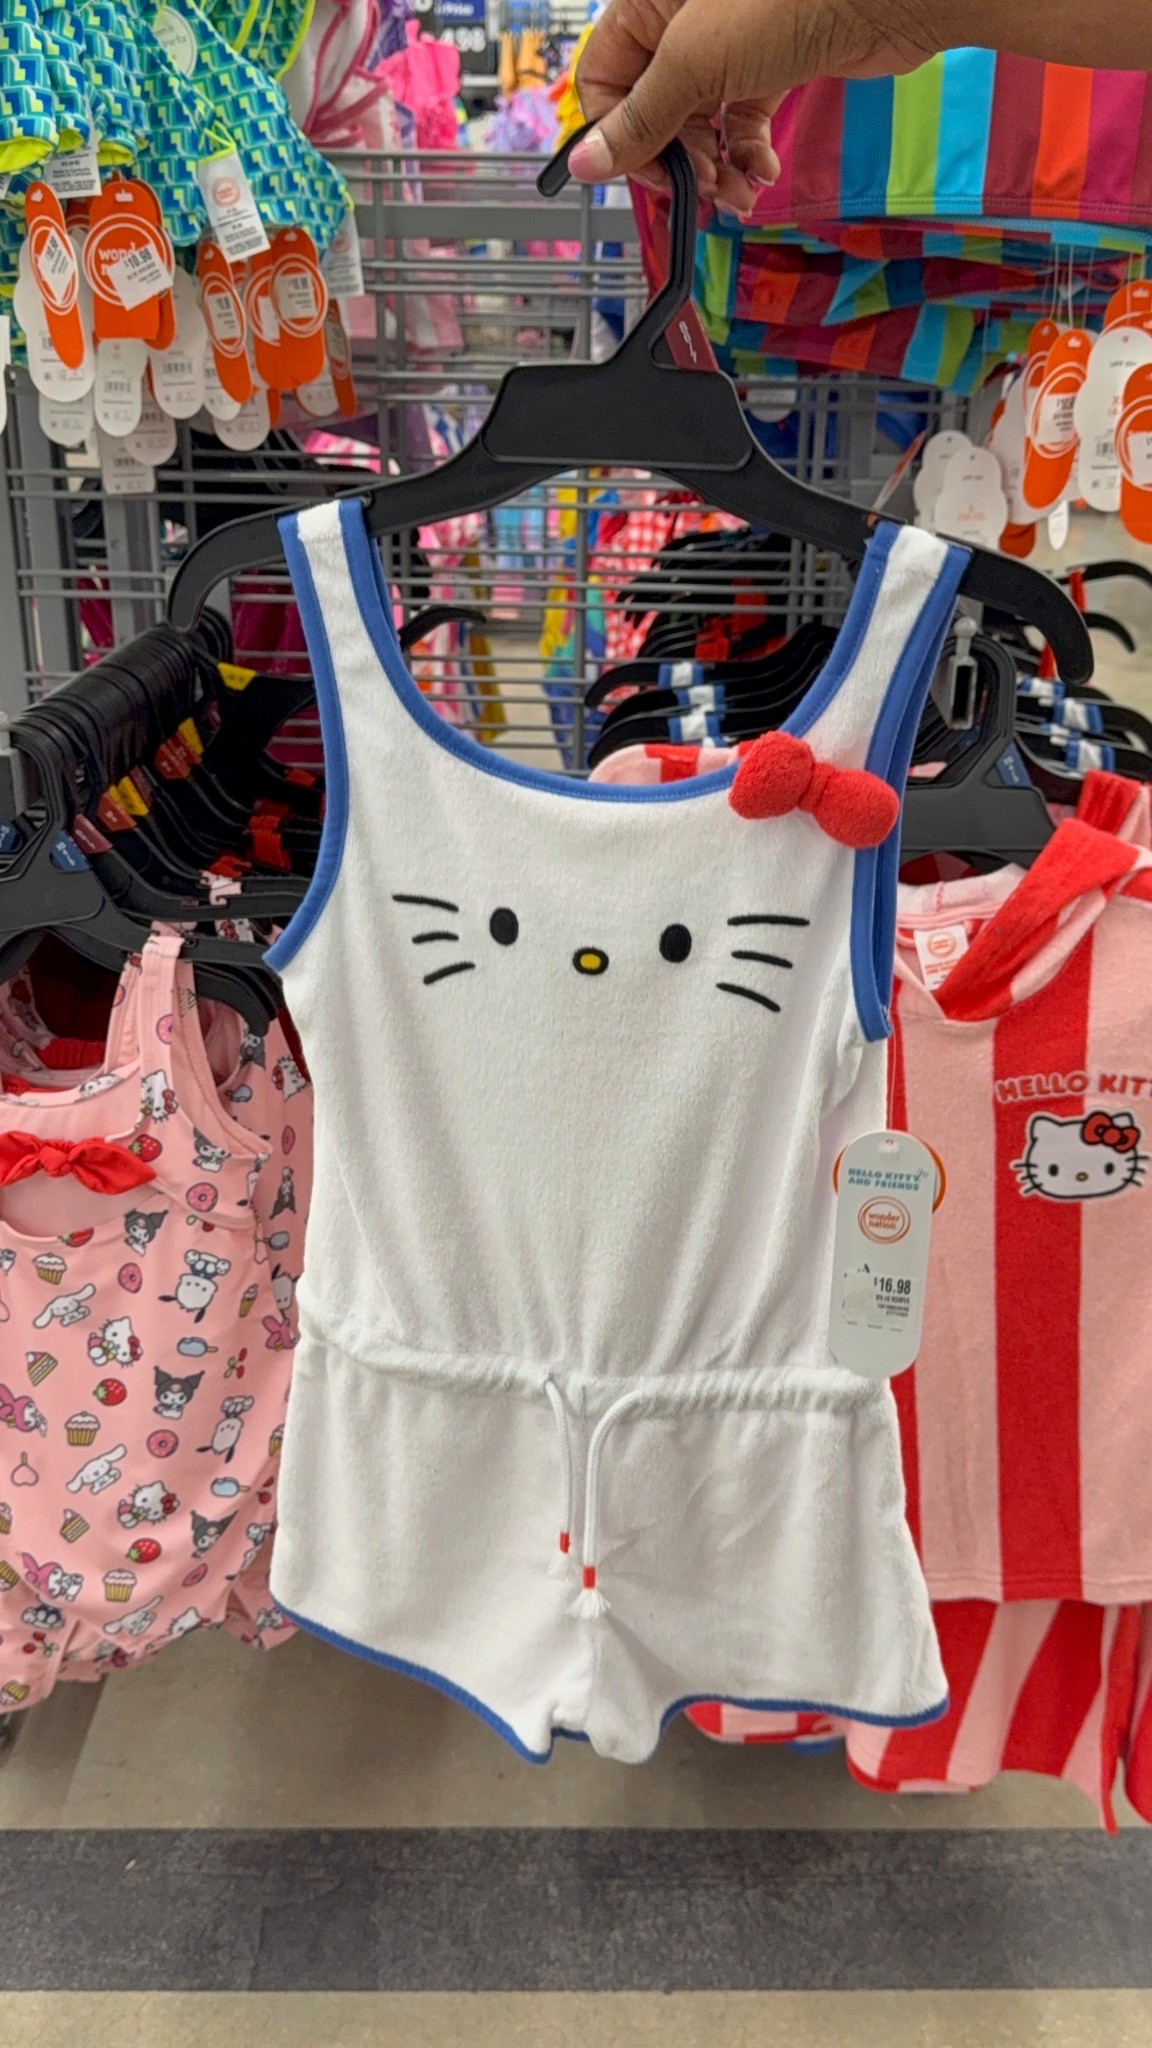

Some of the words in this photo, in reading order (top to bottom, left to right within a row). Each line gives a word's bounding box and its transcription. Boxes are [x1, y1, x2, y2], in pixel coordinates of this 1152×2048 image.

[996, 1072, 1089, 1102] HELLO
[1098, 1072, 1152, 1097] KIT
[848, 1167, 883, 1179] HELLO
[885, 1171, 922, 1182] KITTY
[848, 1176, 872, 1187] AND
[874, 1180, 920, 1192] FRIENDS
[868, 1211, 900, 1222] wonder
[873, 1275, 912, 1295] $16.98
